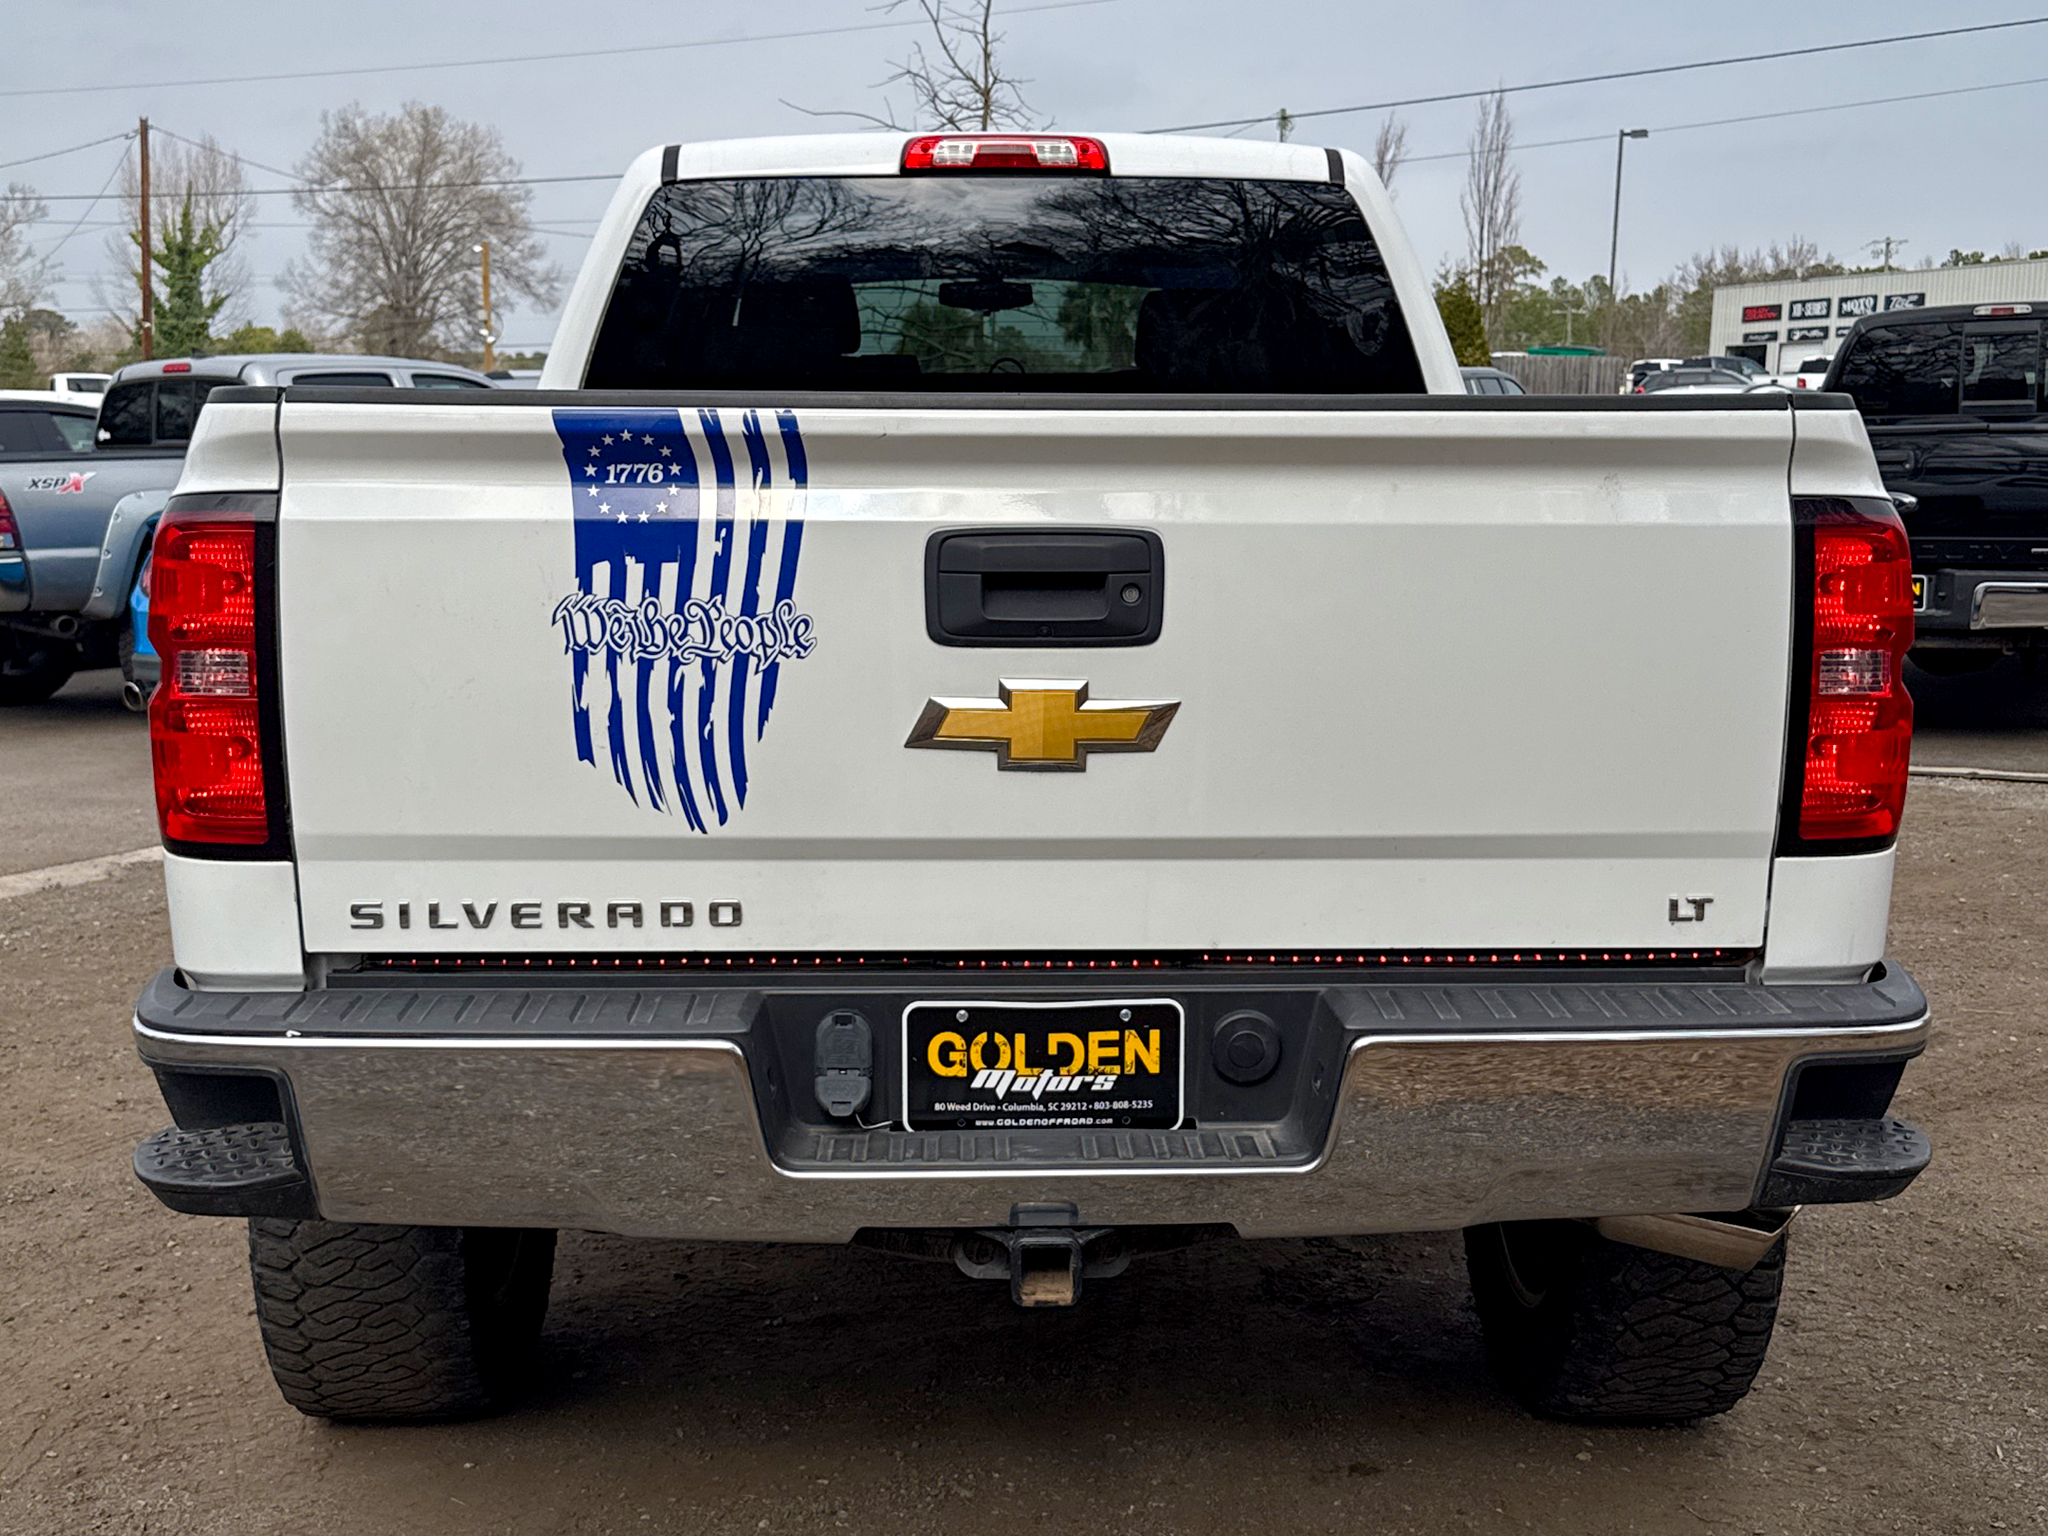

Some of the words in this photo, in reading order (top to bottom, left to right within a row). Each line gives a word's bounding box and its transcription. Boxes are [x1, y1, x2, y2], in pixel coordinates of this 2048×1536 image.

[604, 462, 664, 484] 1776
[350, 898, 742, 930] SILVERADO
[1668, 894, 1714, 922] LT
[927, 1029, 1161, 1077] GOLDEN
[934, 1102, 946, 1111] 80
[946, 1102, 971, 1111] Weed
[972, 1102, 996, 1111] Drive
[1002, 1102, 1046, 1113] Columbia,
[1047, 1102, 1059, 1111] SC
[1060, 1102, 1087, 1111] 29212
[1093, 1100, 1154, 1110] 803-808-5235
